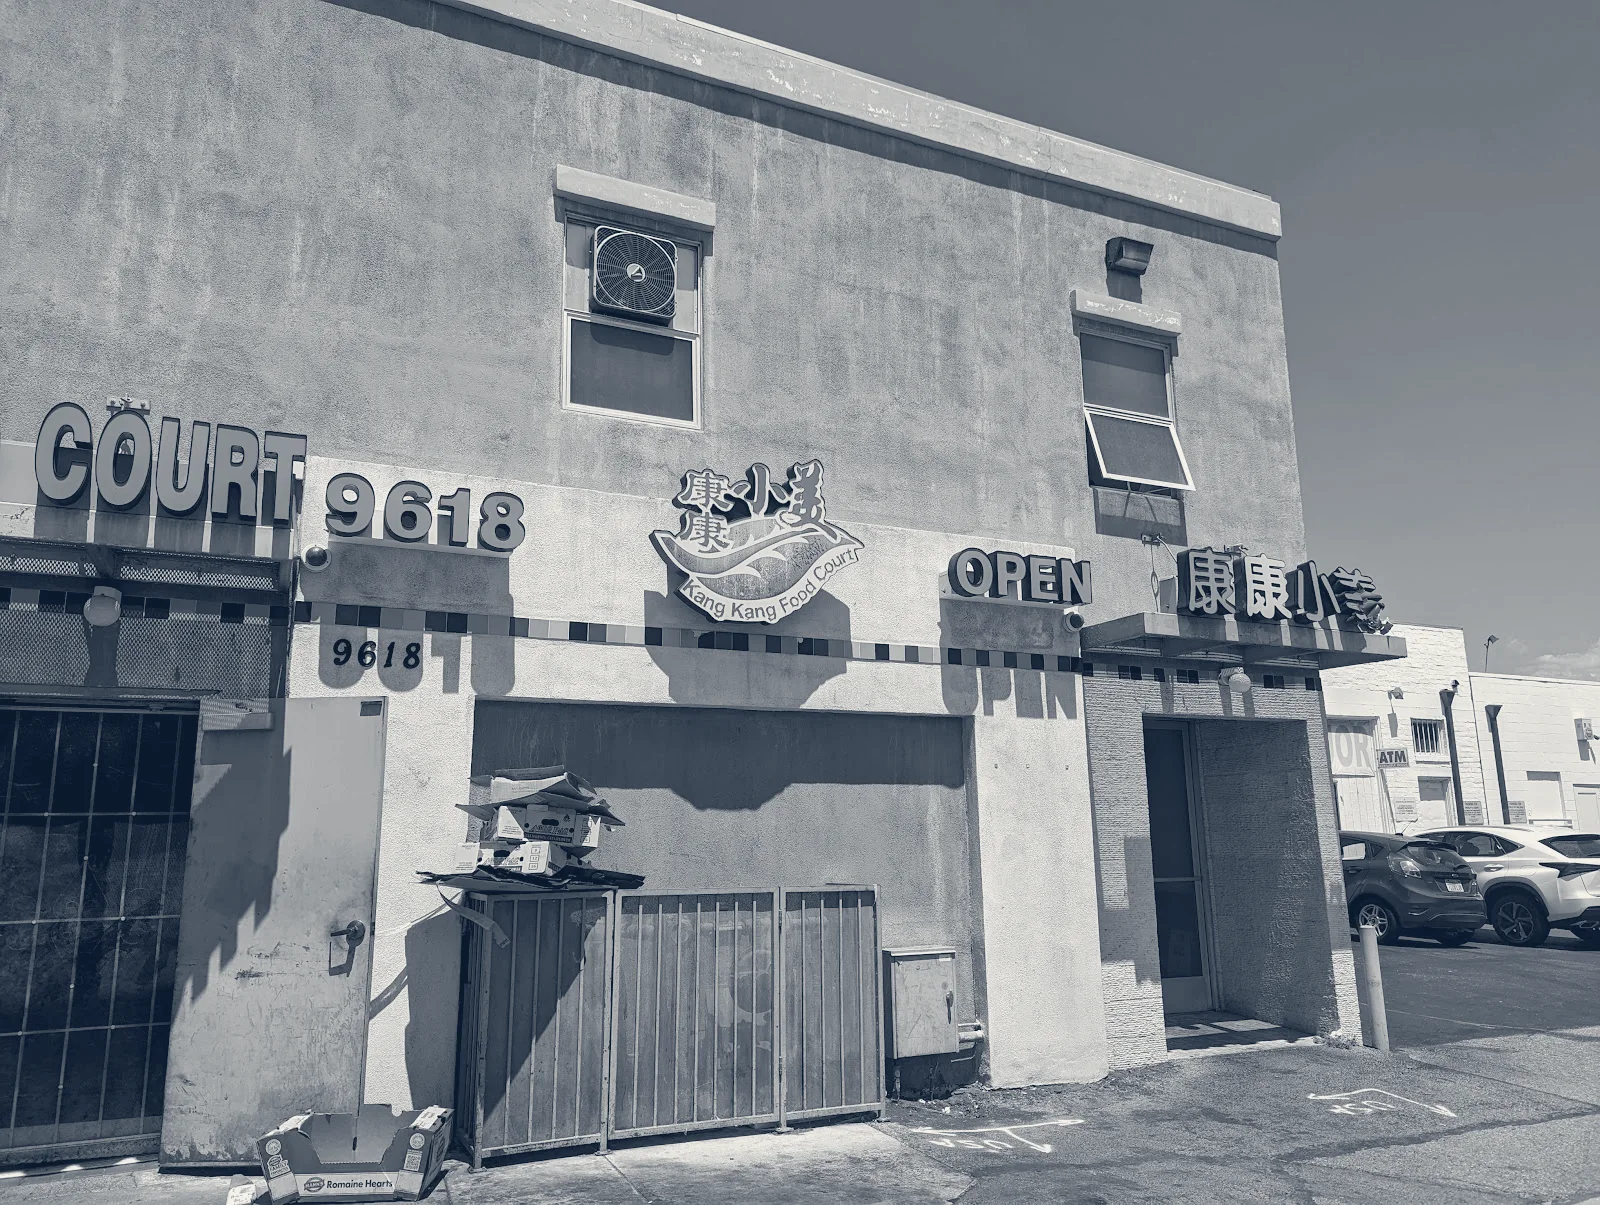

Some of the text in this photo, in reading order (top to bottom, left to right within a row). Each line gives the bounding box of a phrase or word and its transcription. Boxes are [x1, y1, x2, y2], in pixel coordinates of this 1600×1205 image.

[35, 401, 307, 524] COURT
[325, 472, 525, 551] 9618
[682, 547, 855, 621] Kang Kang Food Court
[949, 547, 1092, 604] OPEN
[333, 638, 421, 669] 9618
[1380, 751, 1407, 764] ATM
[326, 1178, 393, 1189] Romaine Hearts
